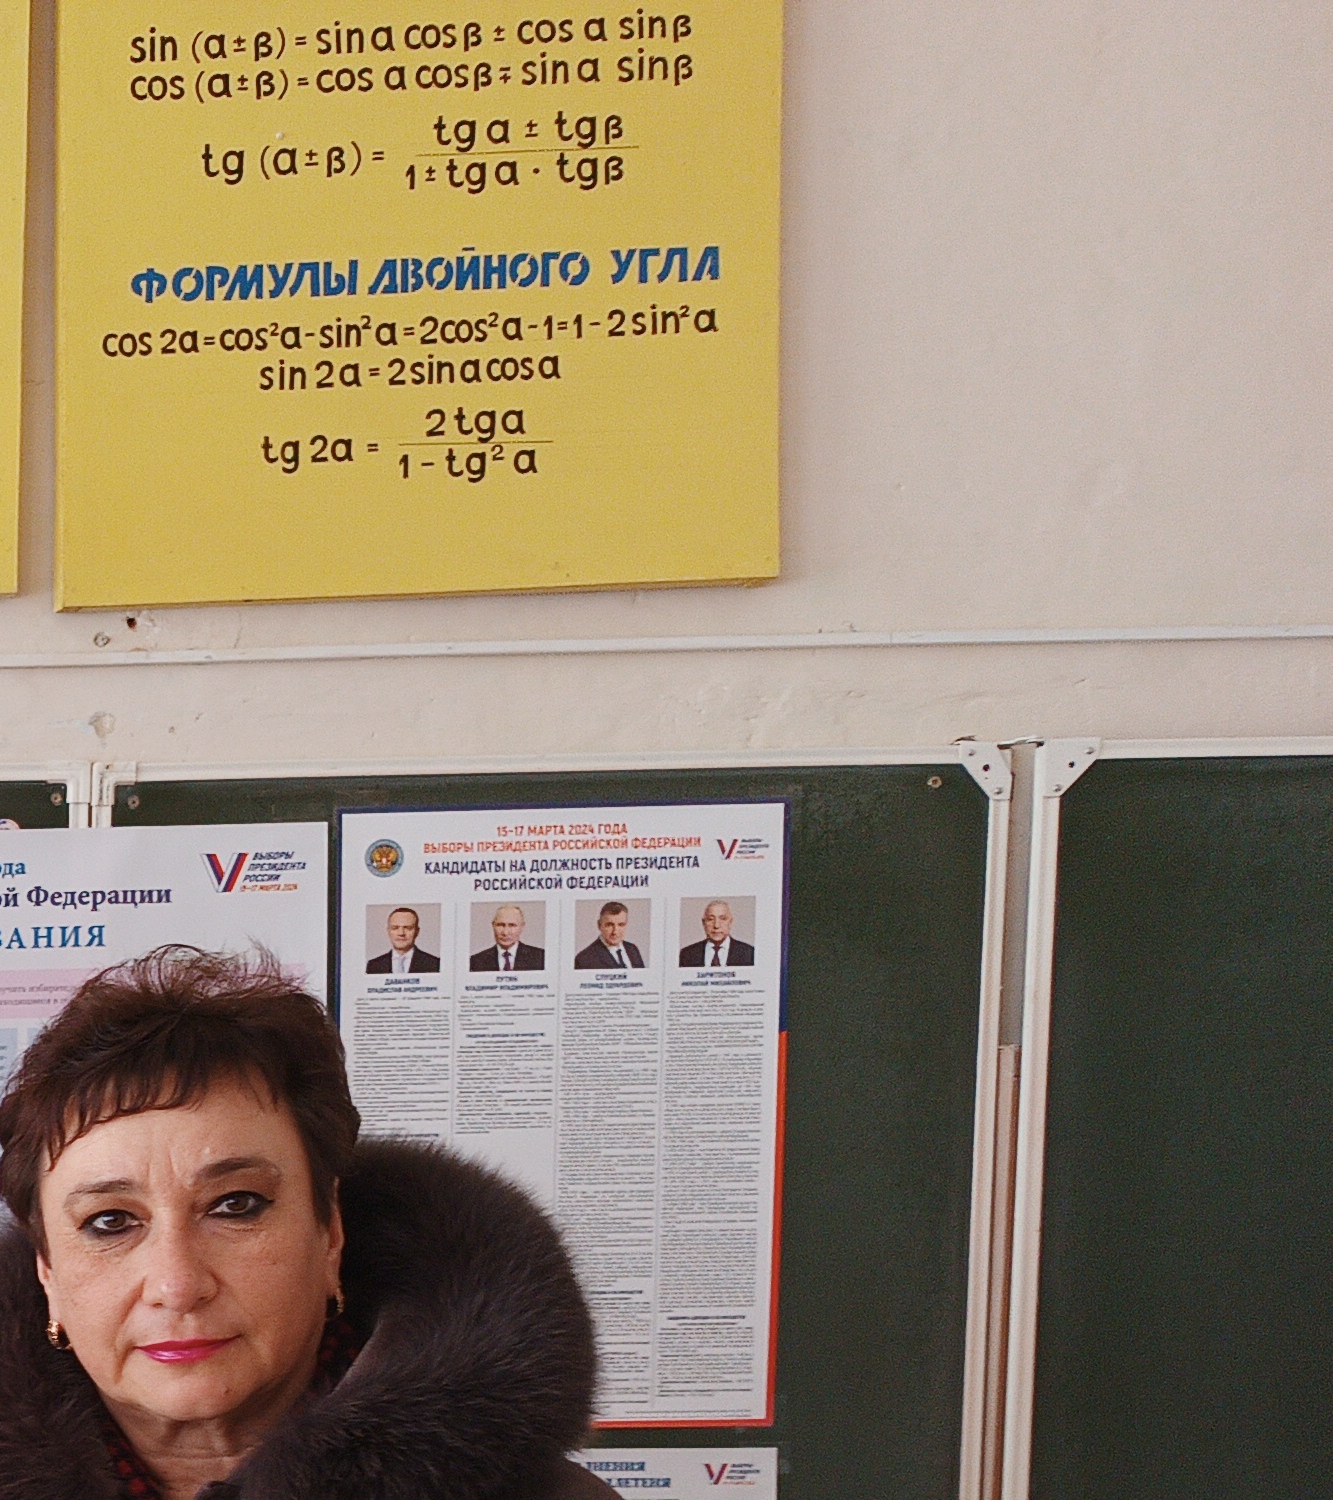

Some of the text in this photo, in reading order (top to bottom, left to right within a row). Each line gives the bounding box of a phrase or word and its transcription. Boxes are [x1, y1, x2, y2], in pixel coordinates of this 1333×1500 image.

[130, 245, 720, 304] ФОРМУЛЫ ДВОЙНОГО УГЛА
[527, 823, 566, 837] МАРТА
[597, 822, 629, 836] ГОДА
[423, 834, 703, 855] ВЫБОРЫ ПРЕЗИДЕНТА РОССИЙСКОЙ ФЕДЕРАЦИИ
[424, 855, 702, 876] КАНДИДАТЫ НА ДОЛЖНОСТЬ ПРЕЗИДЕНТА
[473, 873, 650, 892] РОССИЙСКОЙ ФЕДЕРАЦИИ
[26, 883, 173, 910] Федерации
